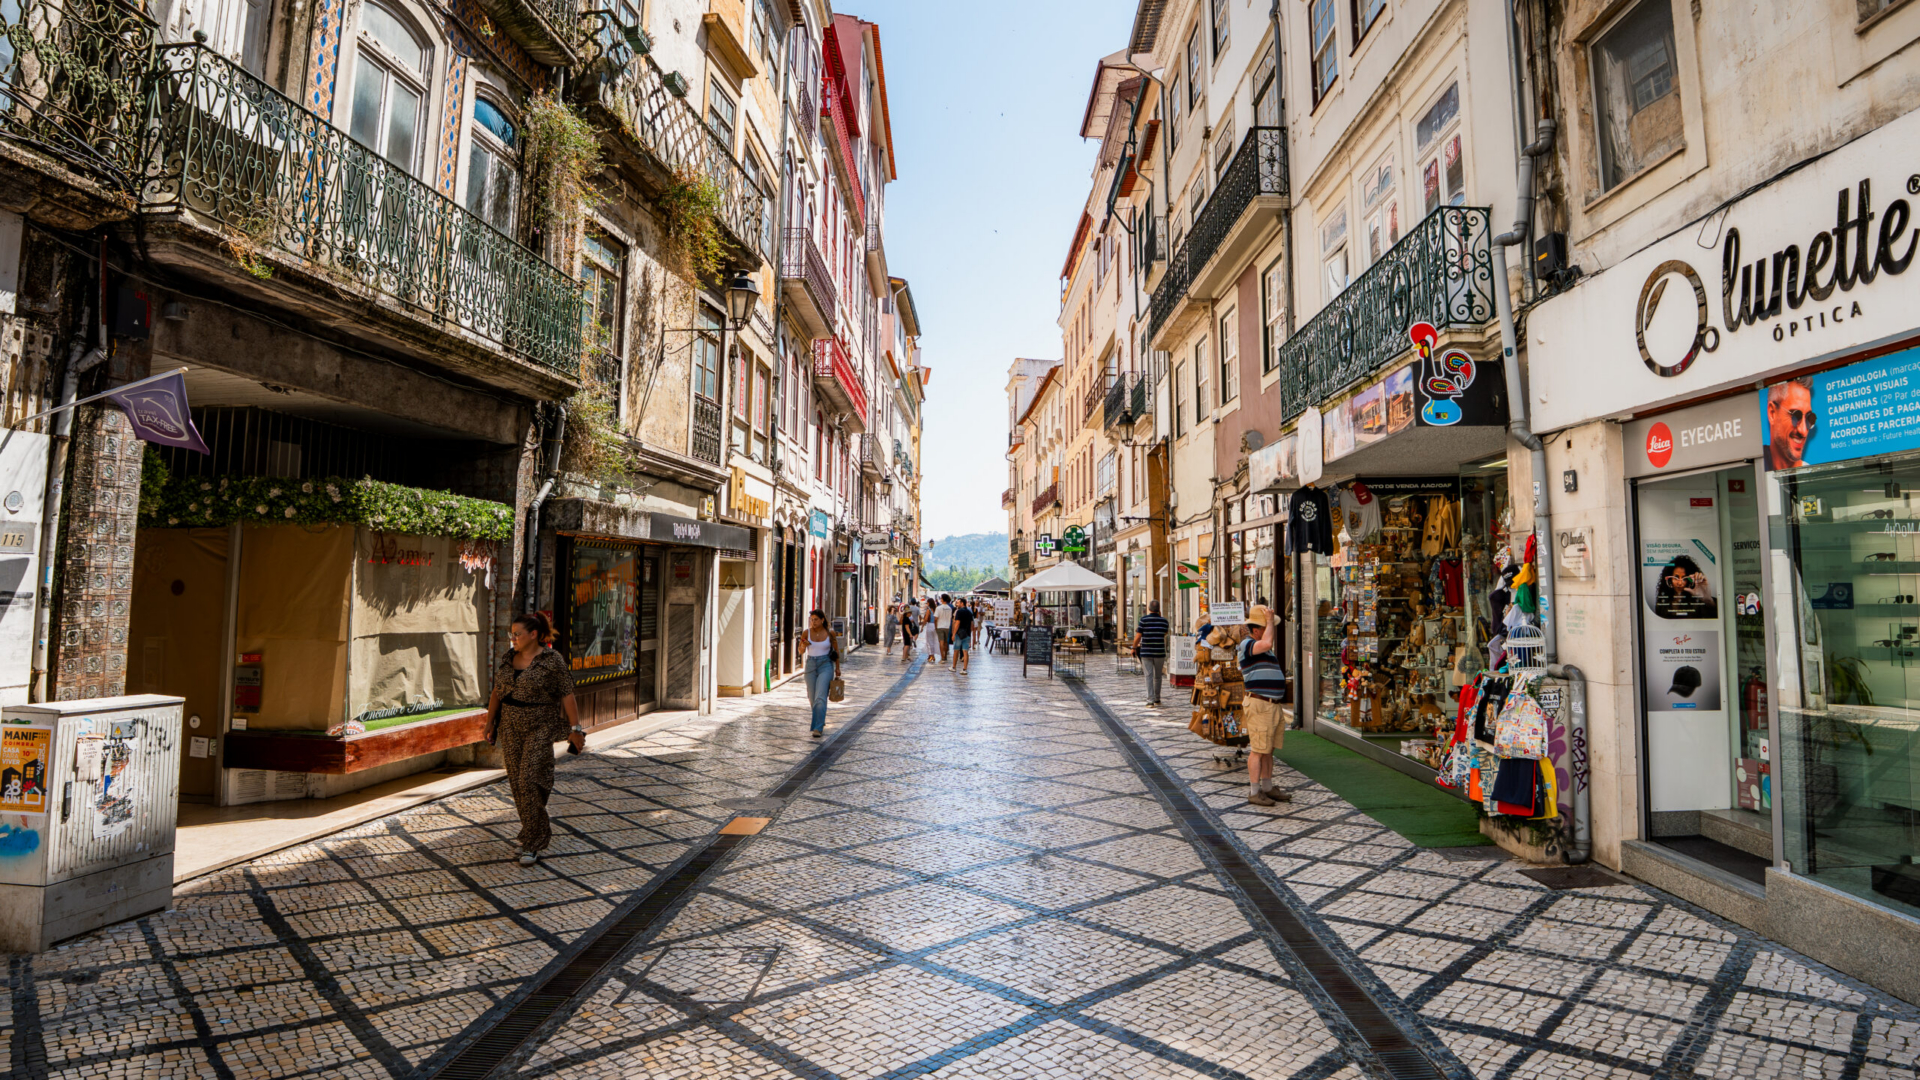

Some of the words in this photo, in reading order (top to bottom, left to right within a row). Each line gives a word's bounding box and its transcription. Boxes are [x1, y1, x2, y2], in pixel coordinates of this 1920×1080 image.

[1773, 300, 1862, 341] ÓPTICA
[1826, 368, 1887, 391] OFTALMOLOGIA
[1827, 386, 1872, 403] RASTREIOS
[1874, 377, 1908, 392] VISUAIS
[1828, 397, 1878, 415] CAMPANHAS
[1880, 394, 1892, 405] (2º
[1894, 391, 1908, 401] Par
[1829, 409, 1880, 427] FACILIDADES
[1883, 406, 1894, 417] DE
[1648, 435, 1671, 453] Leica
[1681, 418, 1742, 447] EYECARE
[1831, 425, 1867, 440] ACORDOS
[1870, 424, 1875, 432] E
[1878, 415, 1920, 431] PARCERIA
[1831, 441, 1847, 449] Médis
[1851, 436, 1878, 446] Medicare
[1882, 430, 1902, 440] Future
[1564, 475, 1573, 486] 94
[3, 534, 24, 546] 115
[1734, 541, 1760, 551] SERVIÇOS
[357, 702, 398, 722] Encanto
[400, 706, 405, 714] e
[407, 694, 444, 713] Tradição
[4, 731, 39, 741] MANIF
[6, 779, 21, 796] 28
[1, 795, 20, 805] JUN
